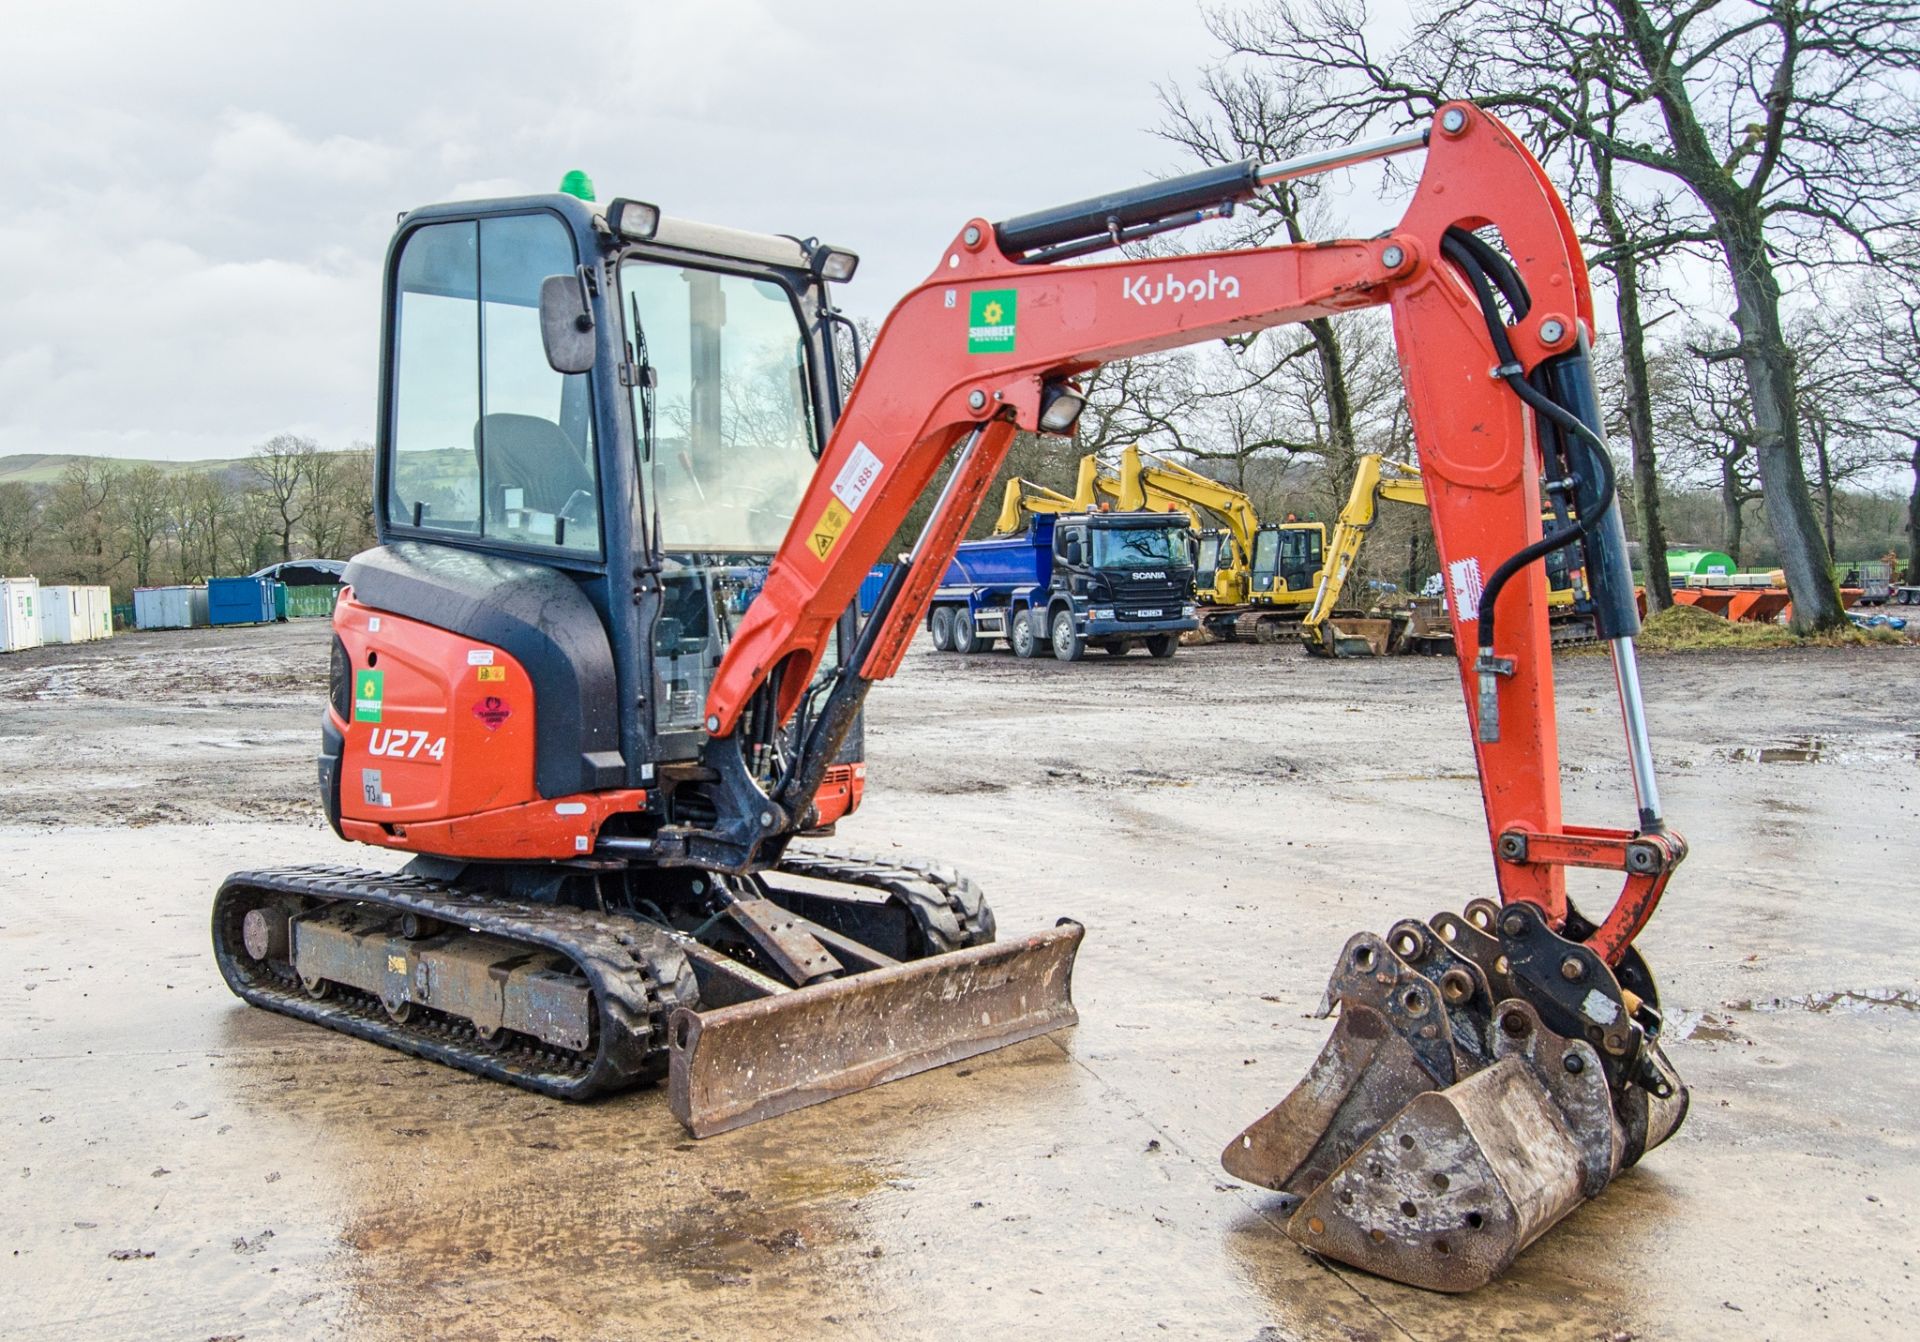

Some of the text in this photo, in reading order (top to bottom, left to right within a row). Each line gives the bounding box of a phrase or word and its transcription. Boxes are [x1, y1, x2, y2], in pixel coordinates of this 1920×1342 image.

[1123, 269, 1239, 305] Kubota
[969, 325, 1015, 338] SUNBELT
[853, 467, 872, 493] 188
[1132, 572, 1166, 580] SCANIA
[369, 728, 446, 761] U27-4
